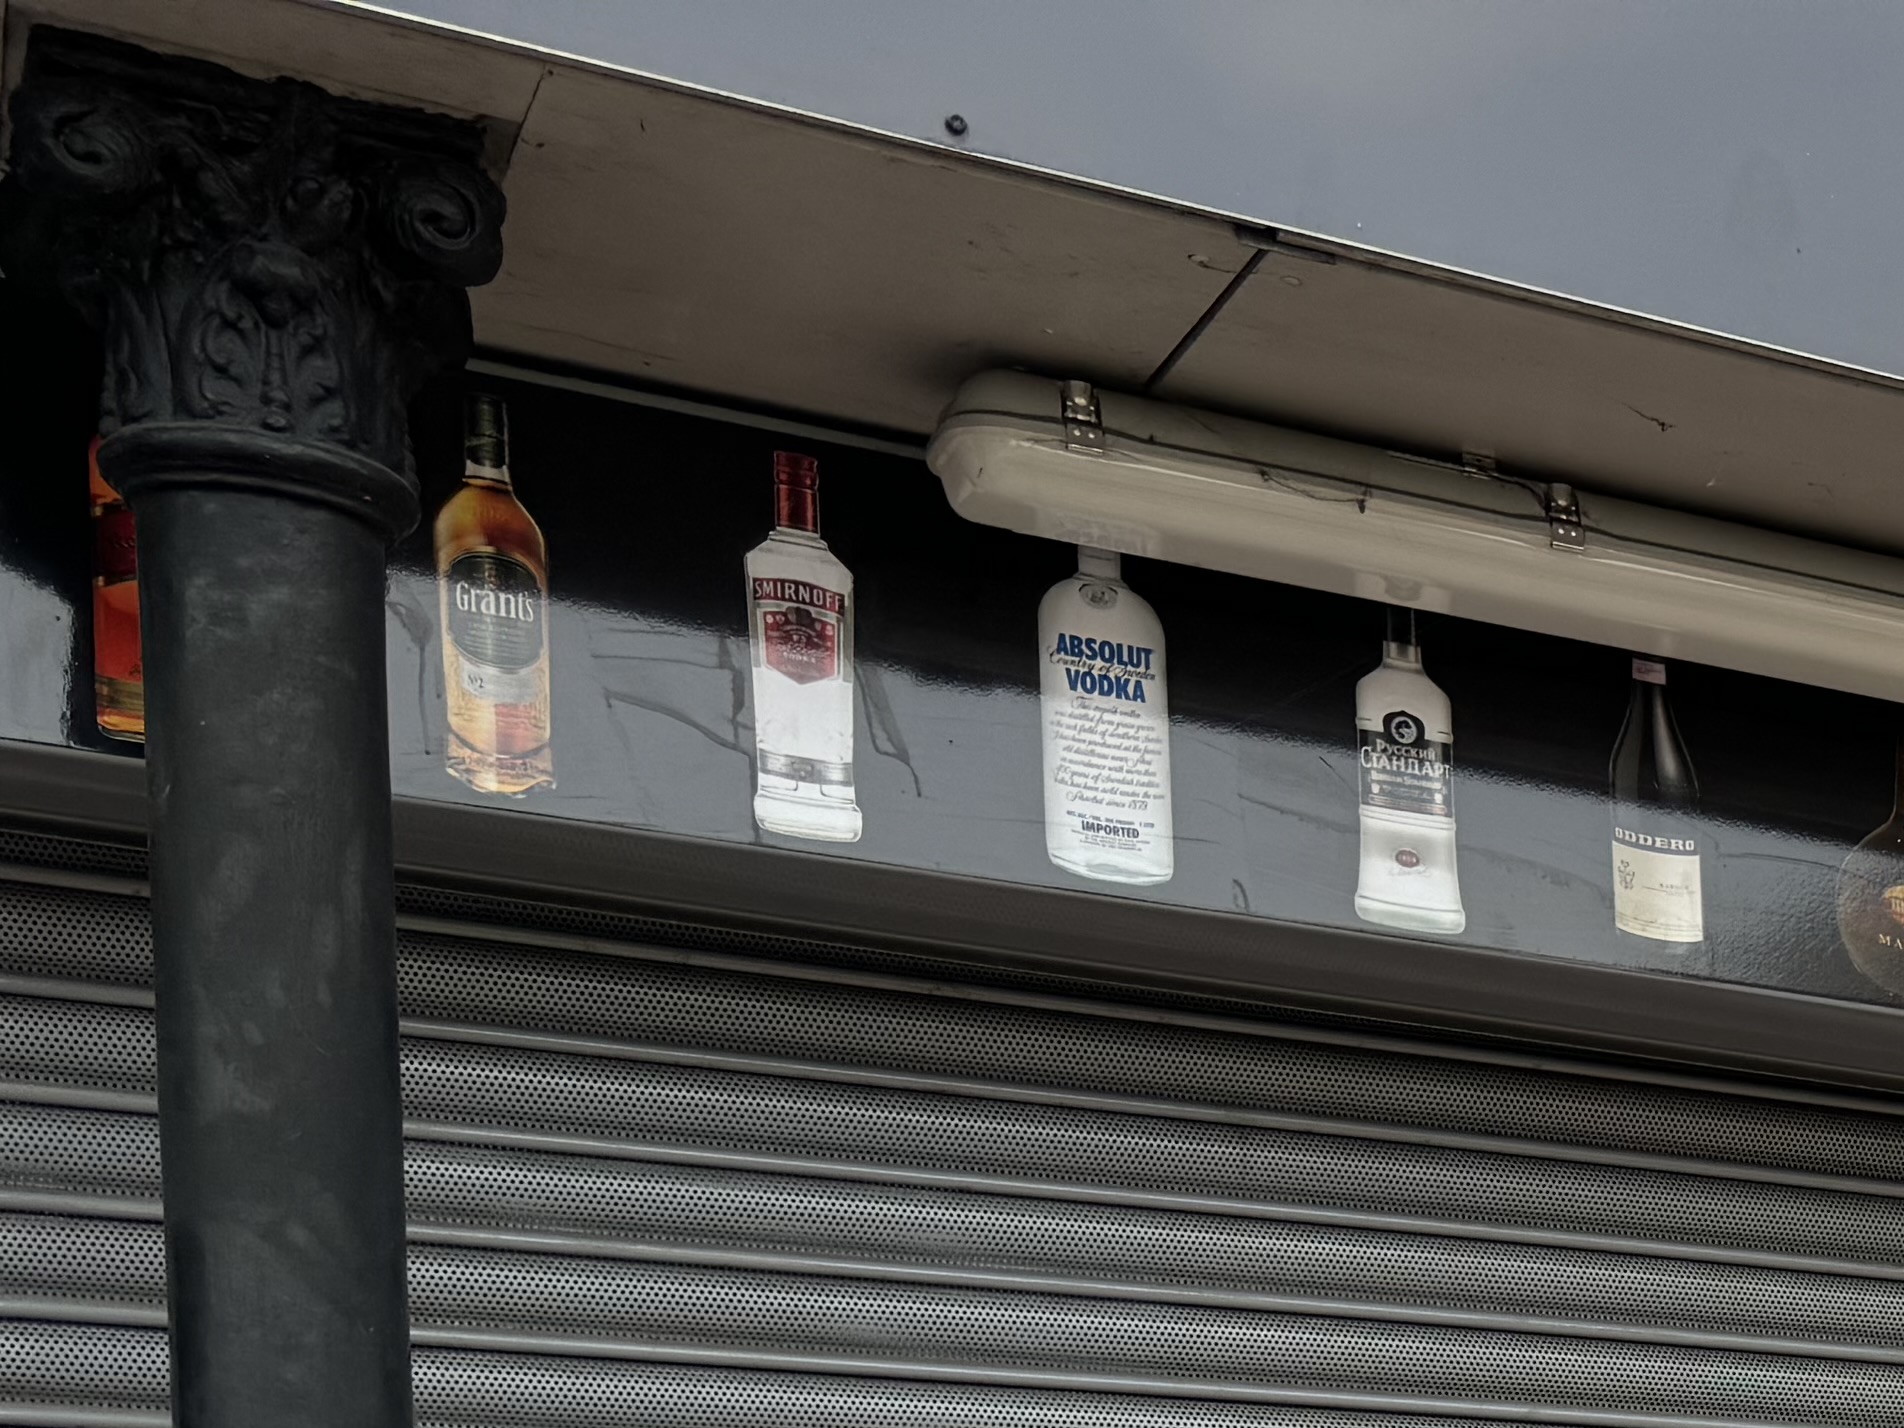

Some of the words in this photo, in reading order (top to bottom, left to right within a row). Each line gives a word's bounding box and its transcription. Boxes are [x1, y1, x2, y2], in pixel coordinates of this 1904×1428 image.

[456, 579, 535, 623] Grant's
[754, 580, 842, 611] SMIRNOFF
[1056, 632, 1155, 671] ABSOLUT
[1064, 667, 1147, 704] VODKA
[1081, 820, 1140, 839] IMPORTED
[1614, 826, 1695, 852] ODDERO
